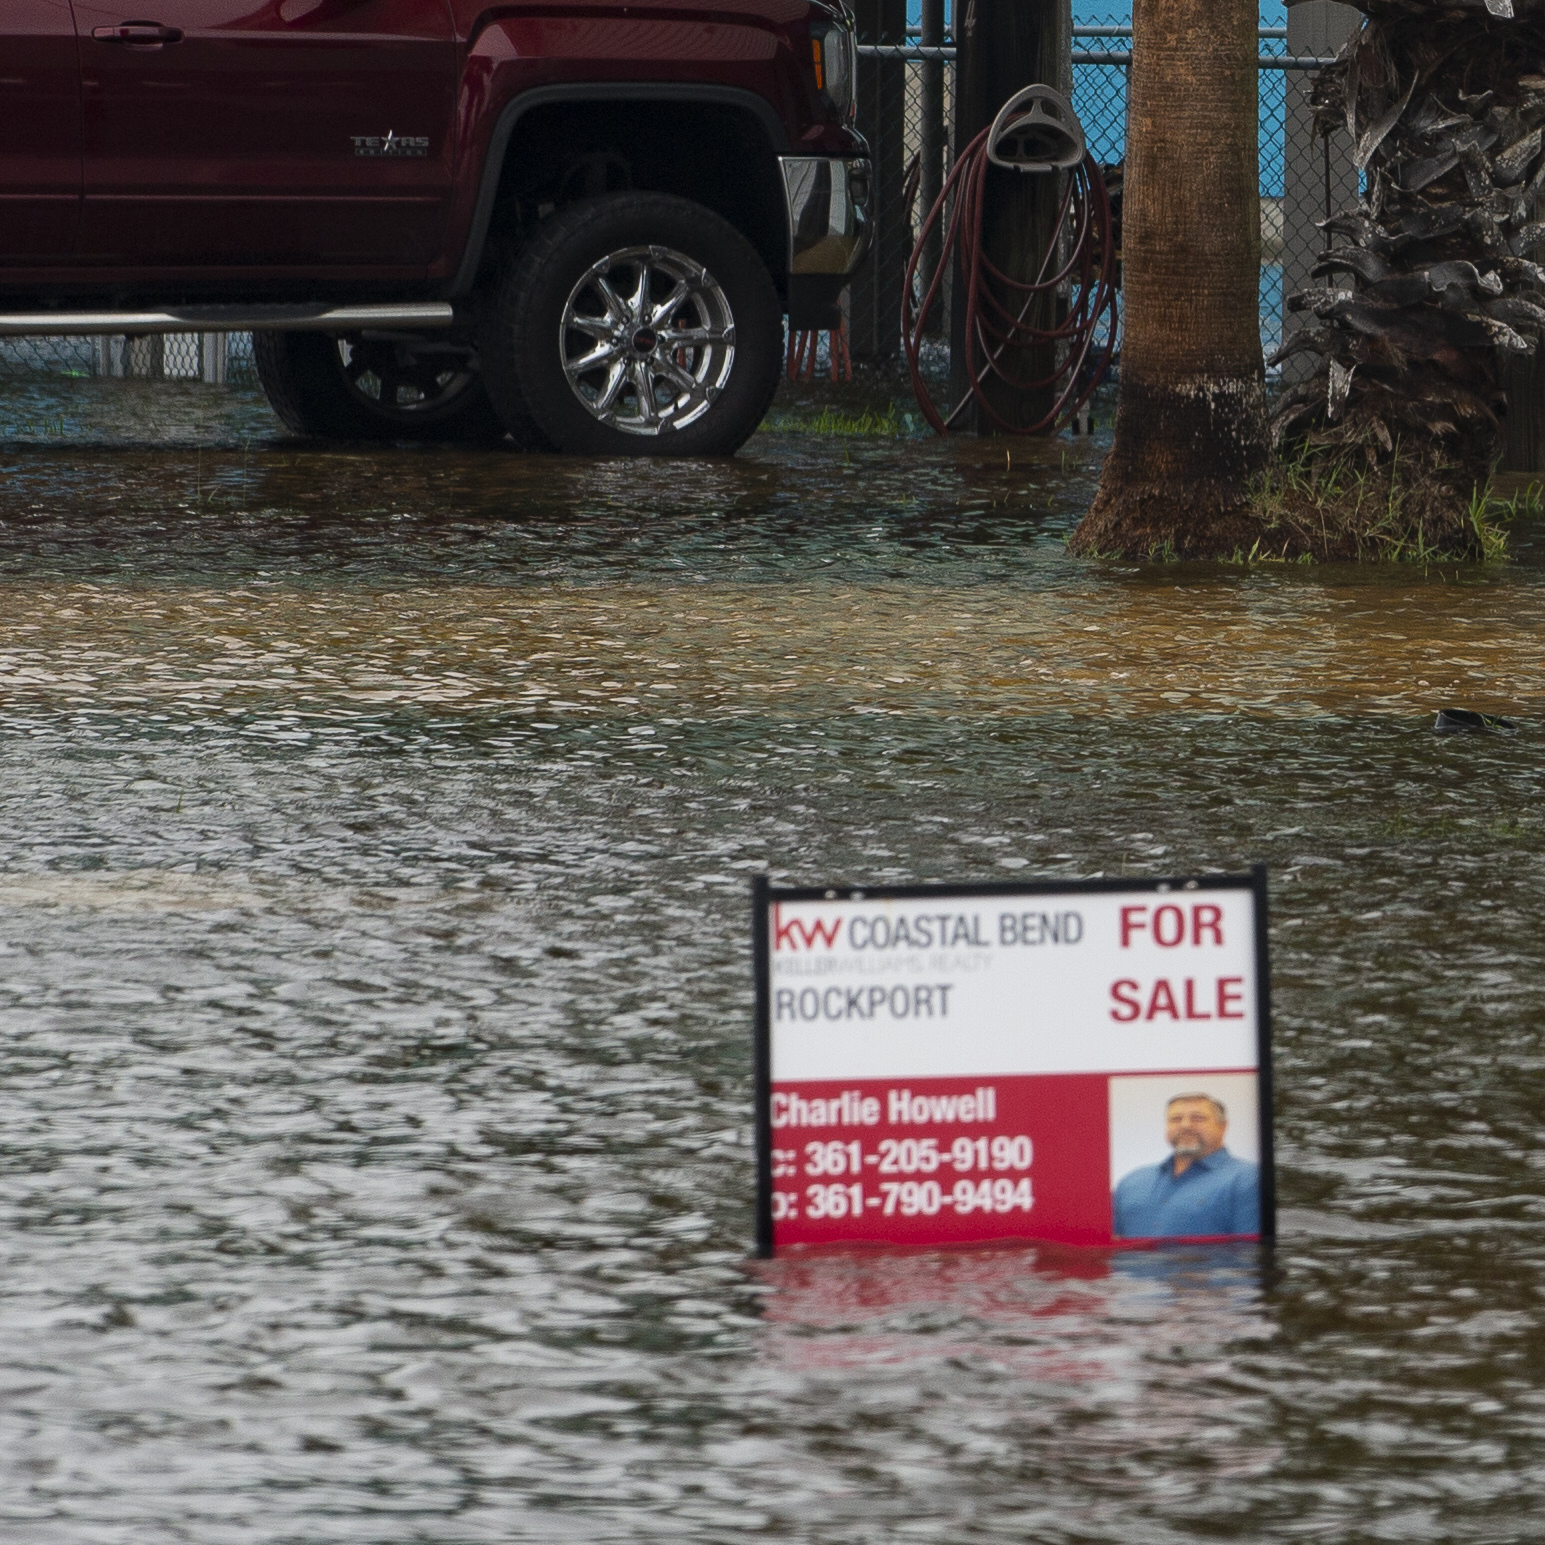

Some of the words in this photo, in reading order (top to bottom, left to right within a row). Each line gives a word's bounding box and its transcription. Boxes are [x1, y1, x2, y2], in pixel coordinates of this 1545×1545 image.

[350, 129, 430, 151] TEXAS
[773, 901, 843, 951] kw
[849, 913, 991, 950] COASTAL
[999, 910, 1084, 947] BEND
[1119, 903, 1225, 948] FOR
[775, 983, 954, 1021] ROCKPORT
[1109, 976, 1245, 1022] SALE
[770, 1091, 881, 1129] Charlie
[887, 1086, 996, 1125] Howell
[804, 1134, 1034, 1177] 361-205-9190
[805, 1177, 1035, 1219] 361-790-9494
